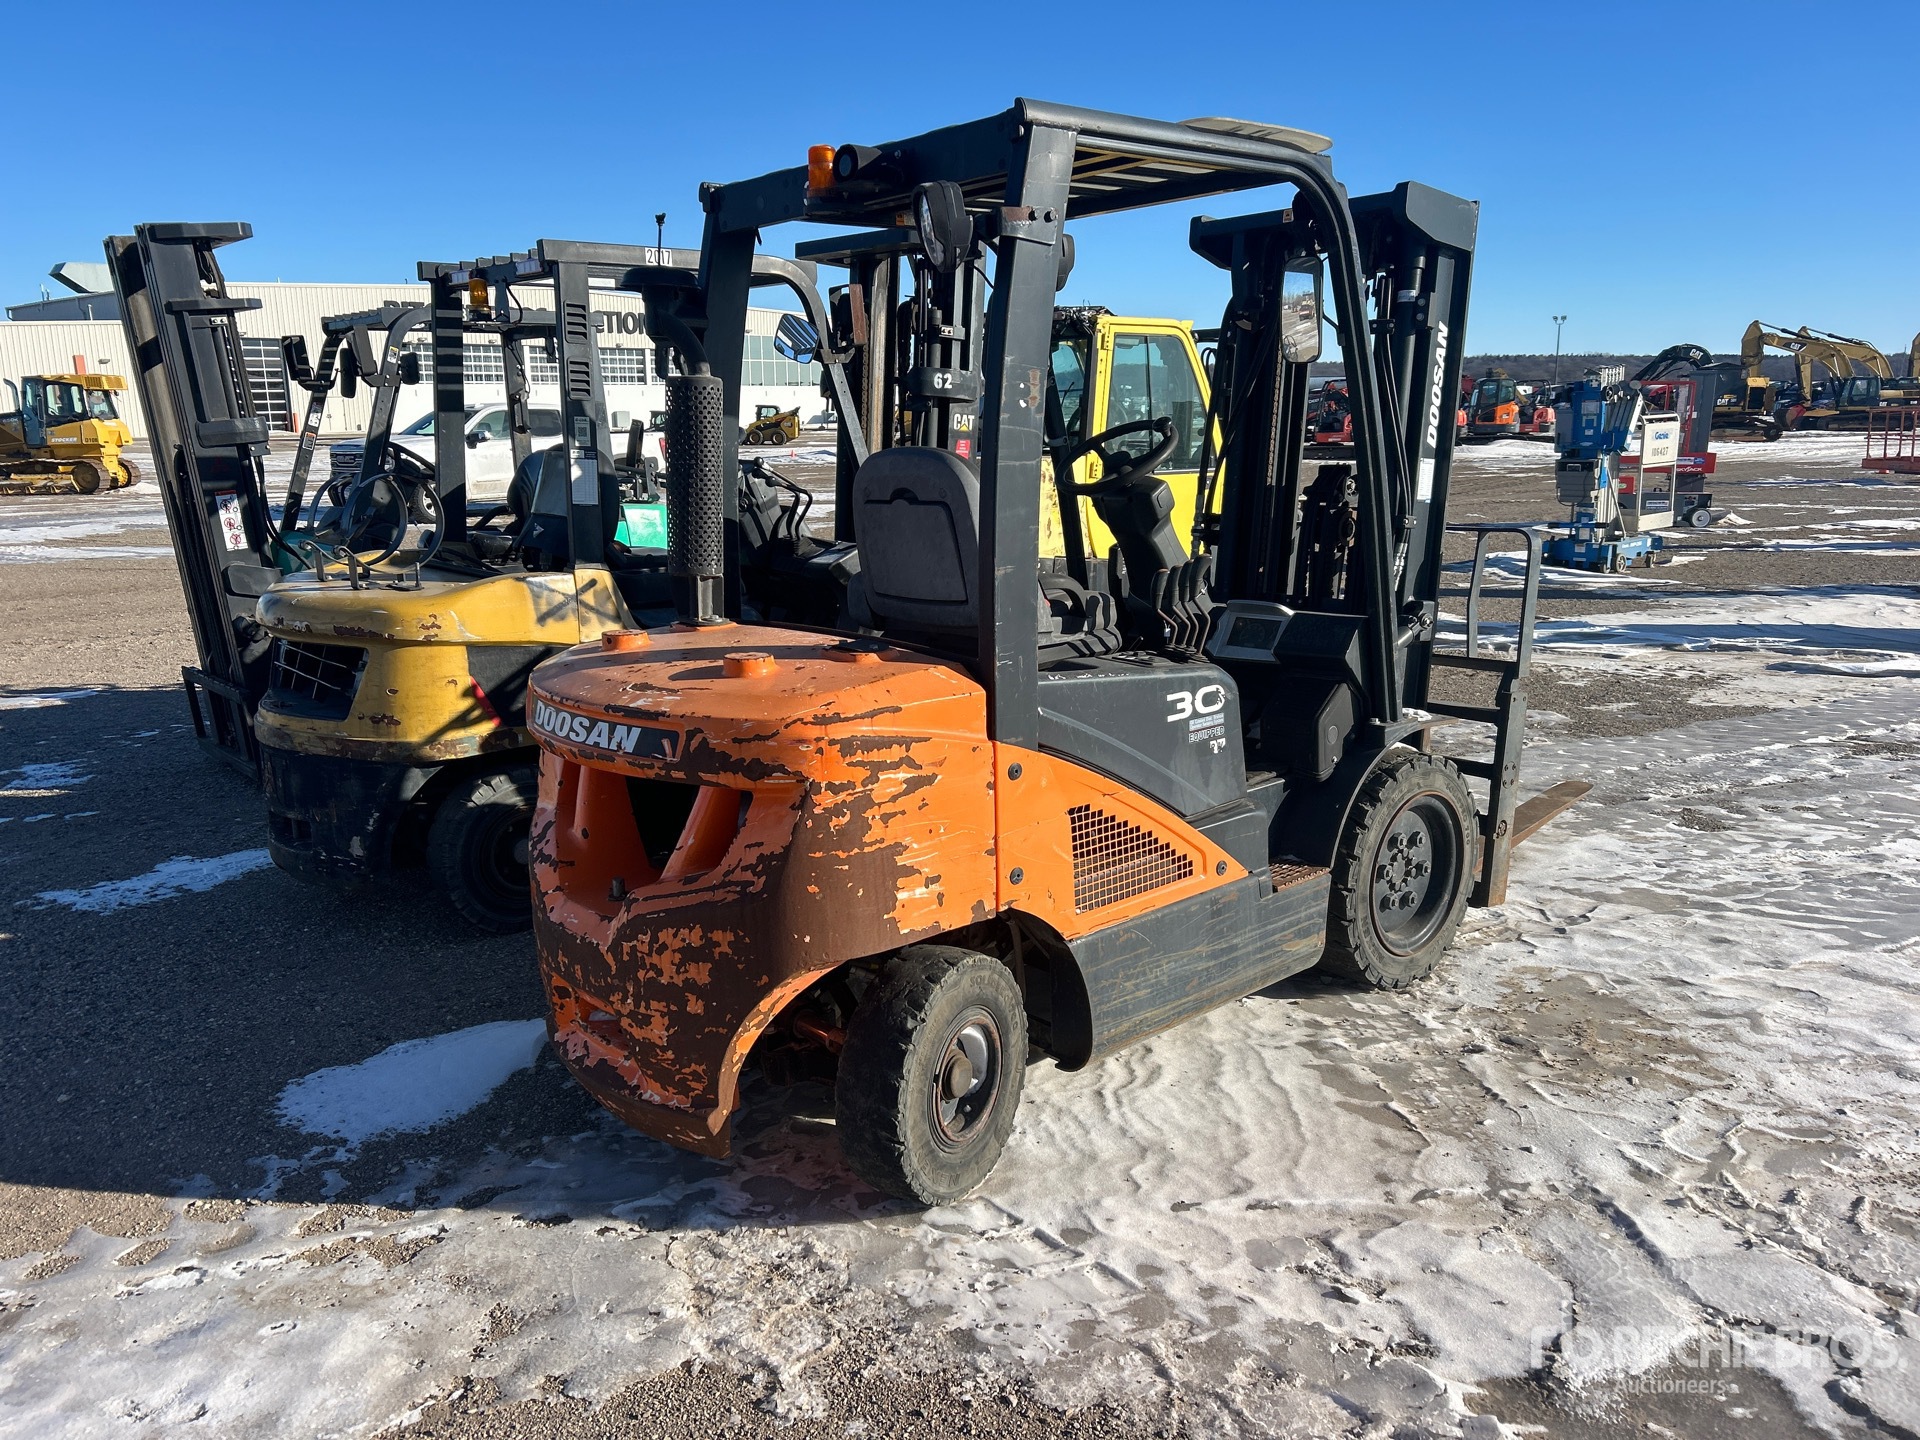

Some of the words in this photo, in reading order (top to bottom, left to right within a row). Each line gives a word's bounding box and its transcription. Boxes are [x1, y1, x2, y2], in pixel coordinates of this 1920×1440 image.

[646, 249, 670, 265] 2017
[1689, 348, 1704, 360] CAT
[1789, 342, 1801, 351] CAT
[933, 372, 953, 389] 62
[1426, 320, 1449, 449] DOOSAN
[1716, 398, 1729, 406] CAT
[953, 413, 975, 431] CAT
[1654, 431, 1670, 440] Genie
[1166, 684, 1226, 722] 30
[534, 699, 642, 753] DOOSAN
[1188, 725, 1225, 744] EQUIPPED
